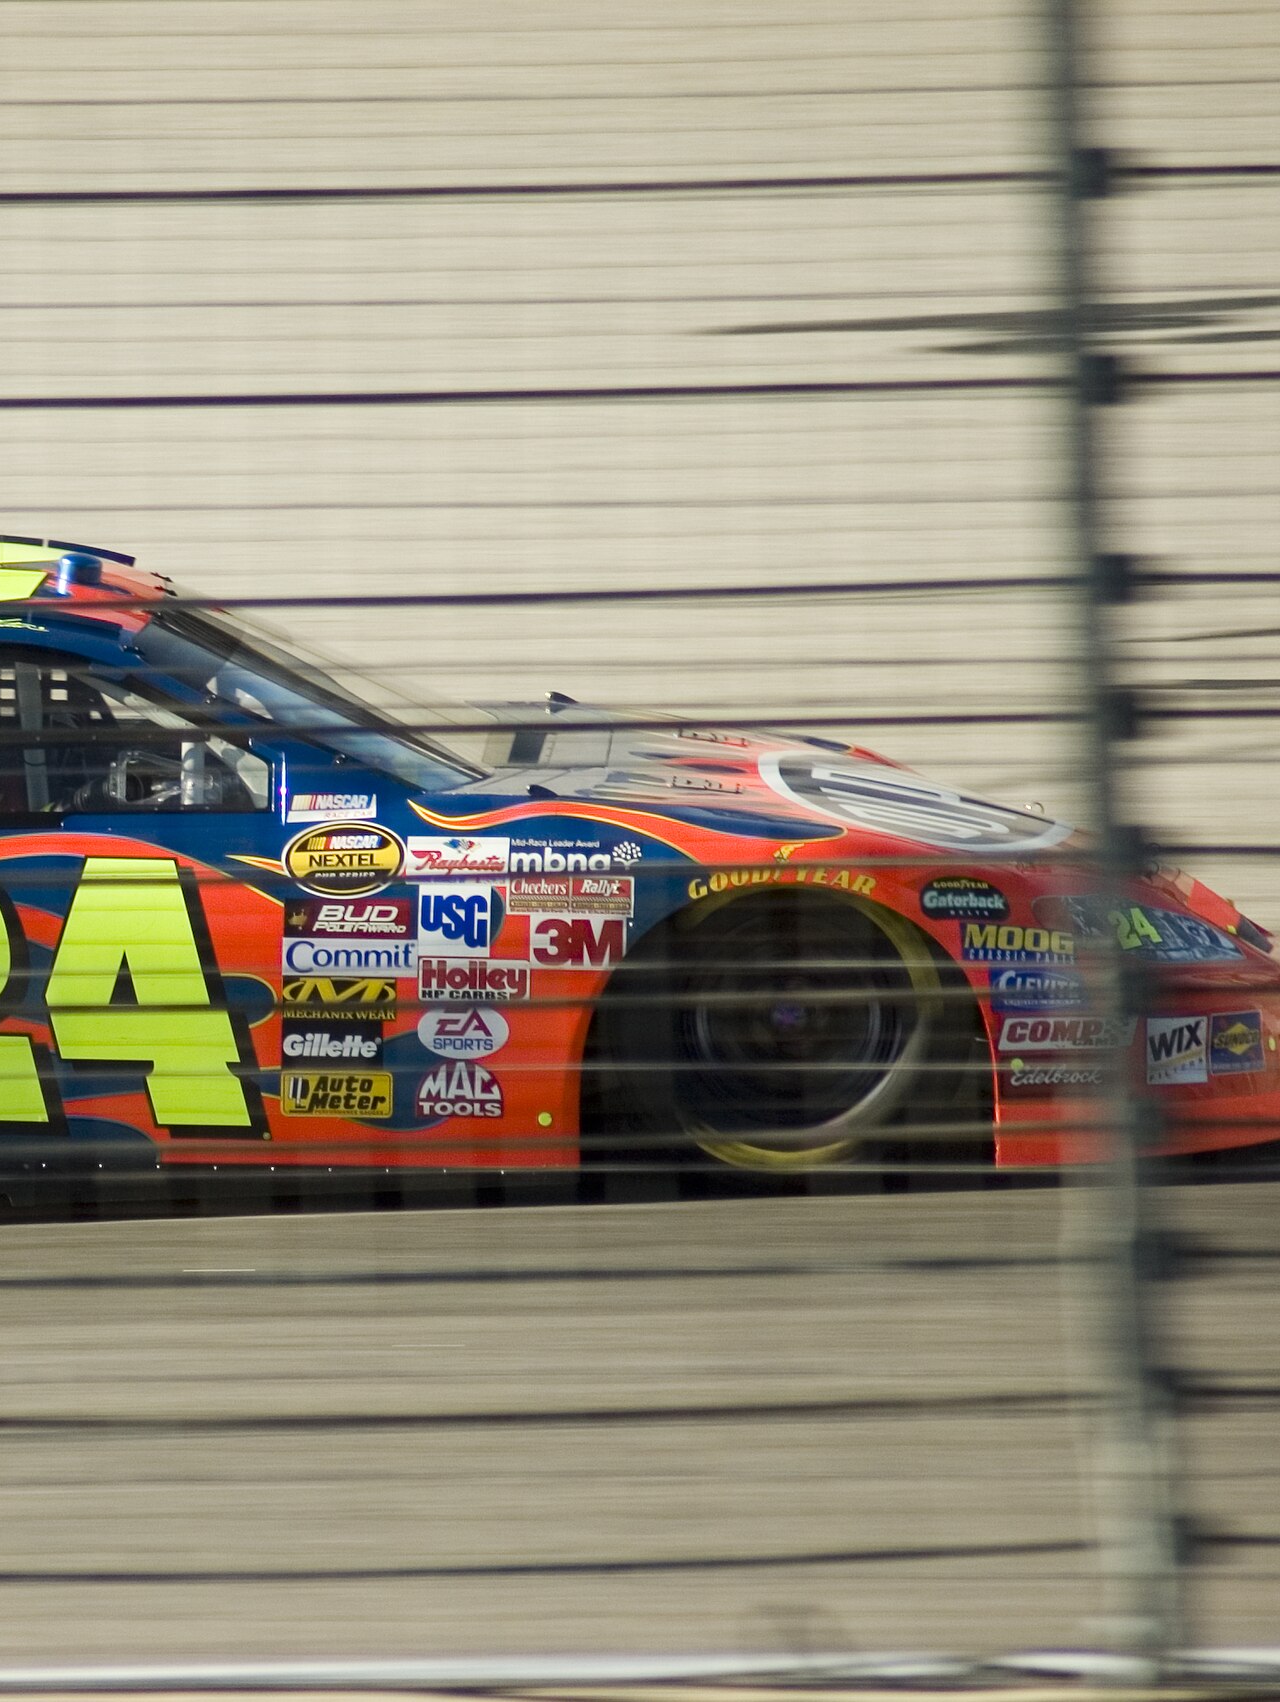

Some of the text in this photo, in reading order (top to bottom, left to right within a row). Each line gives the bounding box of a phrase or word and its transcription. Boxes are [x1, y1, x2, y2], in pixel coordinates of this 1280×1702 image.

[314, 794, 369, 810] NASCAR
[329, 834, 379, 849] NASCAR
[511, 838, 600, 848] Mid-Race Leader Award
[309, 853, 381, 867] NEXTEL
[510, 847, 611, 873] mbna
[511, 878, 568, 895] Checkers
[923, 890, 1005, 910] Gatorback
[317, 904, 399, 922] BUD
[421, 895, 488, 947] USG
[1107, 907, 1163, 950] 24
[533, 918, 624, 967] 3M
[964, 923, 1075, 955] MOOG
[286, 940, 413, 974] Commit
[969, 949, 1027, 961] CHASSIS
[422, 959, 527, 999] Holley
[422, 989, 508, 1000] HP CARBS
[283, 1008, 396, 1019] MECHANIX WEAR
[434, 1005, 493, 1037] EA
[1006, 1020, 1101, 1044] COMP
[1149, 1020, 1203, 1062] WIX
[283, 1033, 378, 1058] Gillette
[433, 1037, 494, 1050] SPORTS
[313, 1076, 373, 1092] Auto
[419, 1061, 502, 1100] MAC
[308, 1093, 387, 1114] Meter
[419, 1102, 502, 1117] TOOLS
